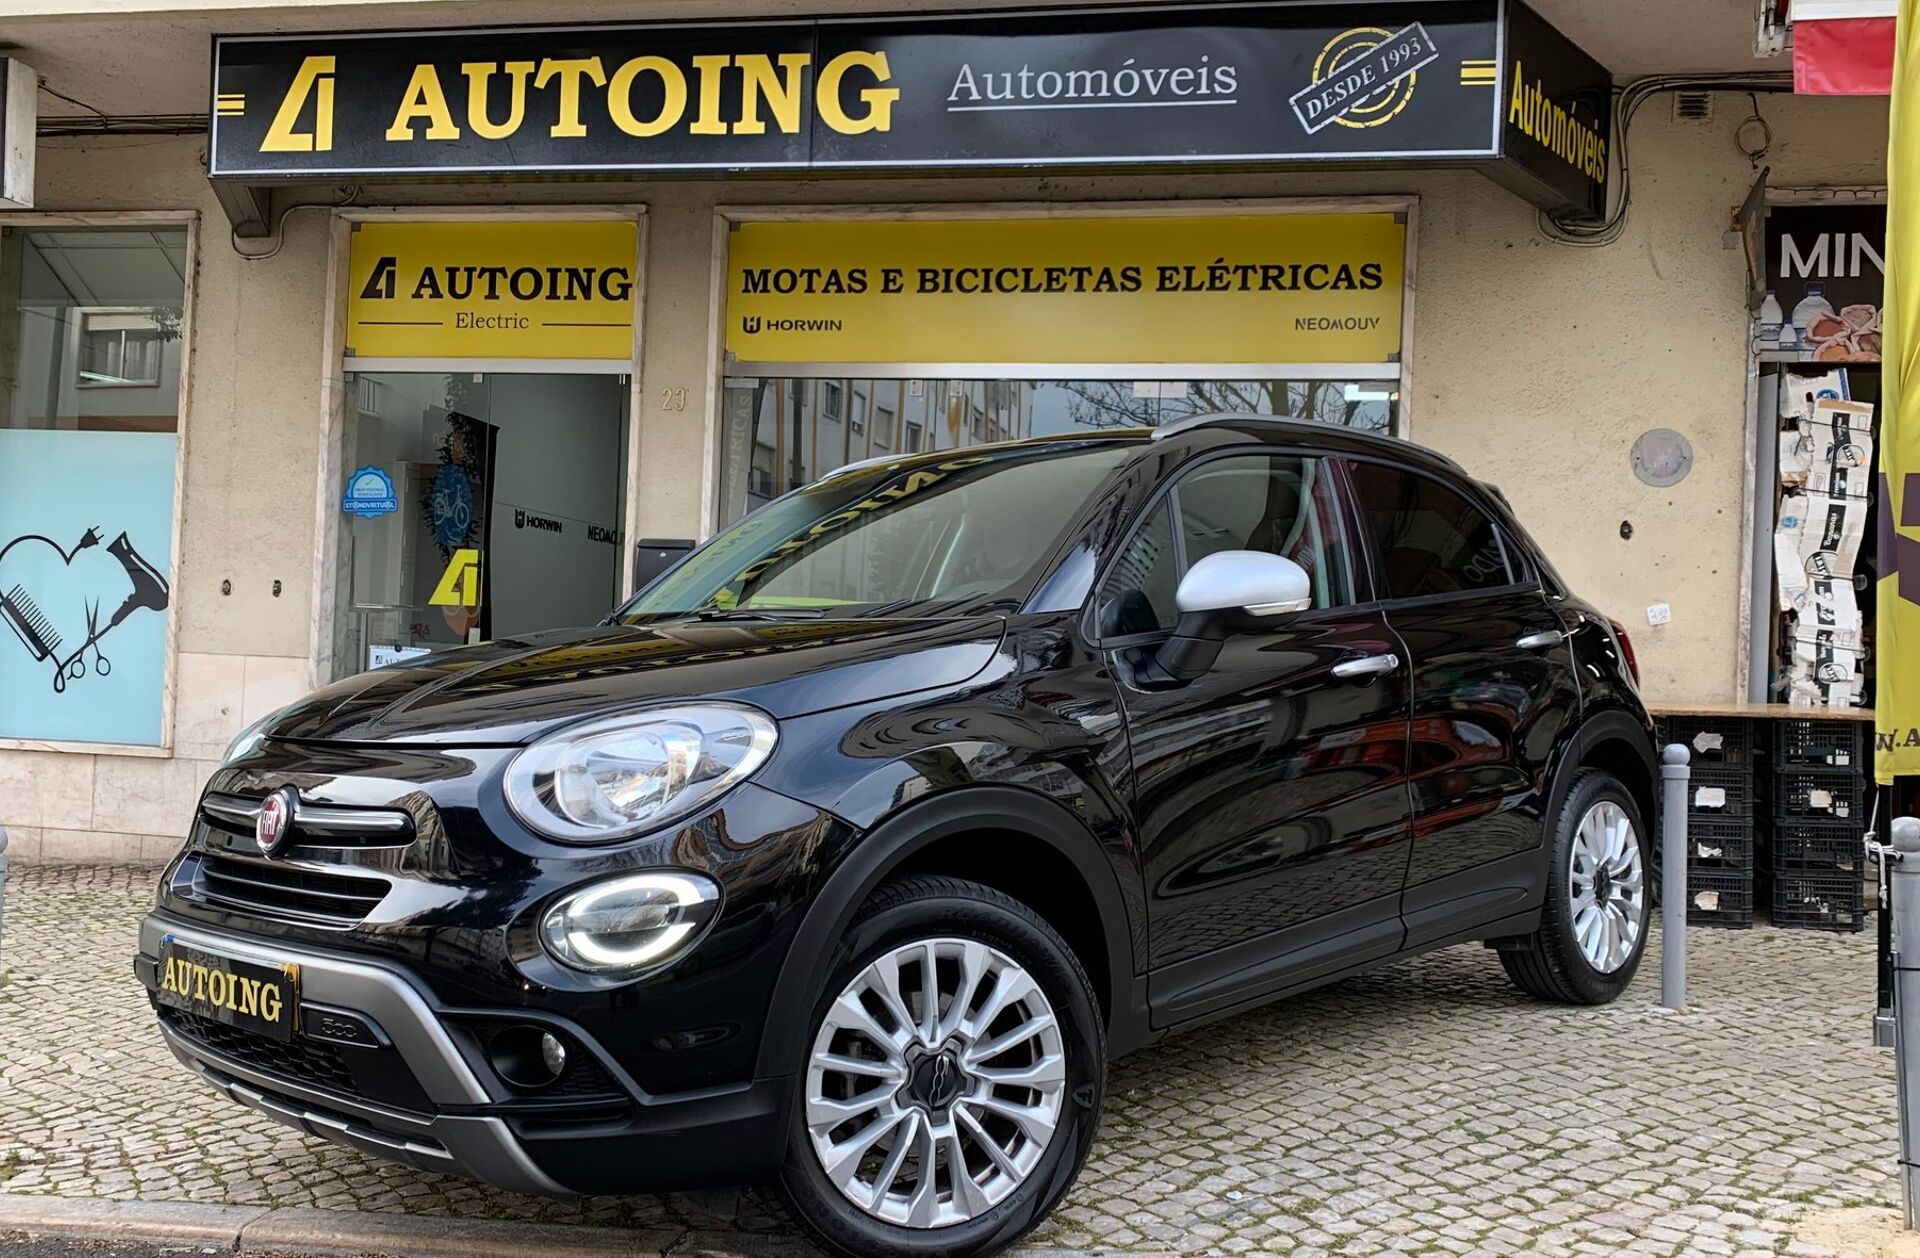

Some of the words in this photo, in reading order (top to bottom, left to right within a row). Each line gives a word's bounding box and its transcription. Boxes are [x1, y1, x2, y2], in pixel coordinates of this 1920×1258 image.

[947, 54, 1238, 101] Automóveis
[1306, 64, 1376, 119] DESDE
[1379, 37, 1422, 74] 1993
[385, 51, 900, 141] AUTOING
[1509, 60, 1606, 184] Automóveis
[411, 266, 633, 301] AUTOING
[741, 268, 868, 294] MOTAS
[880, 269, 904, 294] E
[917, 266, 1142, 294] BICICLETAS
[1156, 257, 1383, 292] ELÉTRICAS
[455, 311, 529, 330] Electric
[766, 319, 843, 332] HORWIN
[1295, 317, 1380, 331] NEOMOUV
[662, 387, 687, 412] 23
[526, 514, 563, 534] HORWIN
[162, 956, 283, 1023] AUTOING
